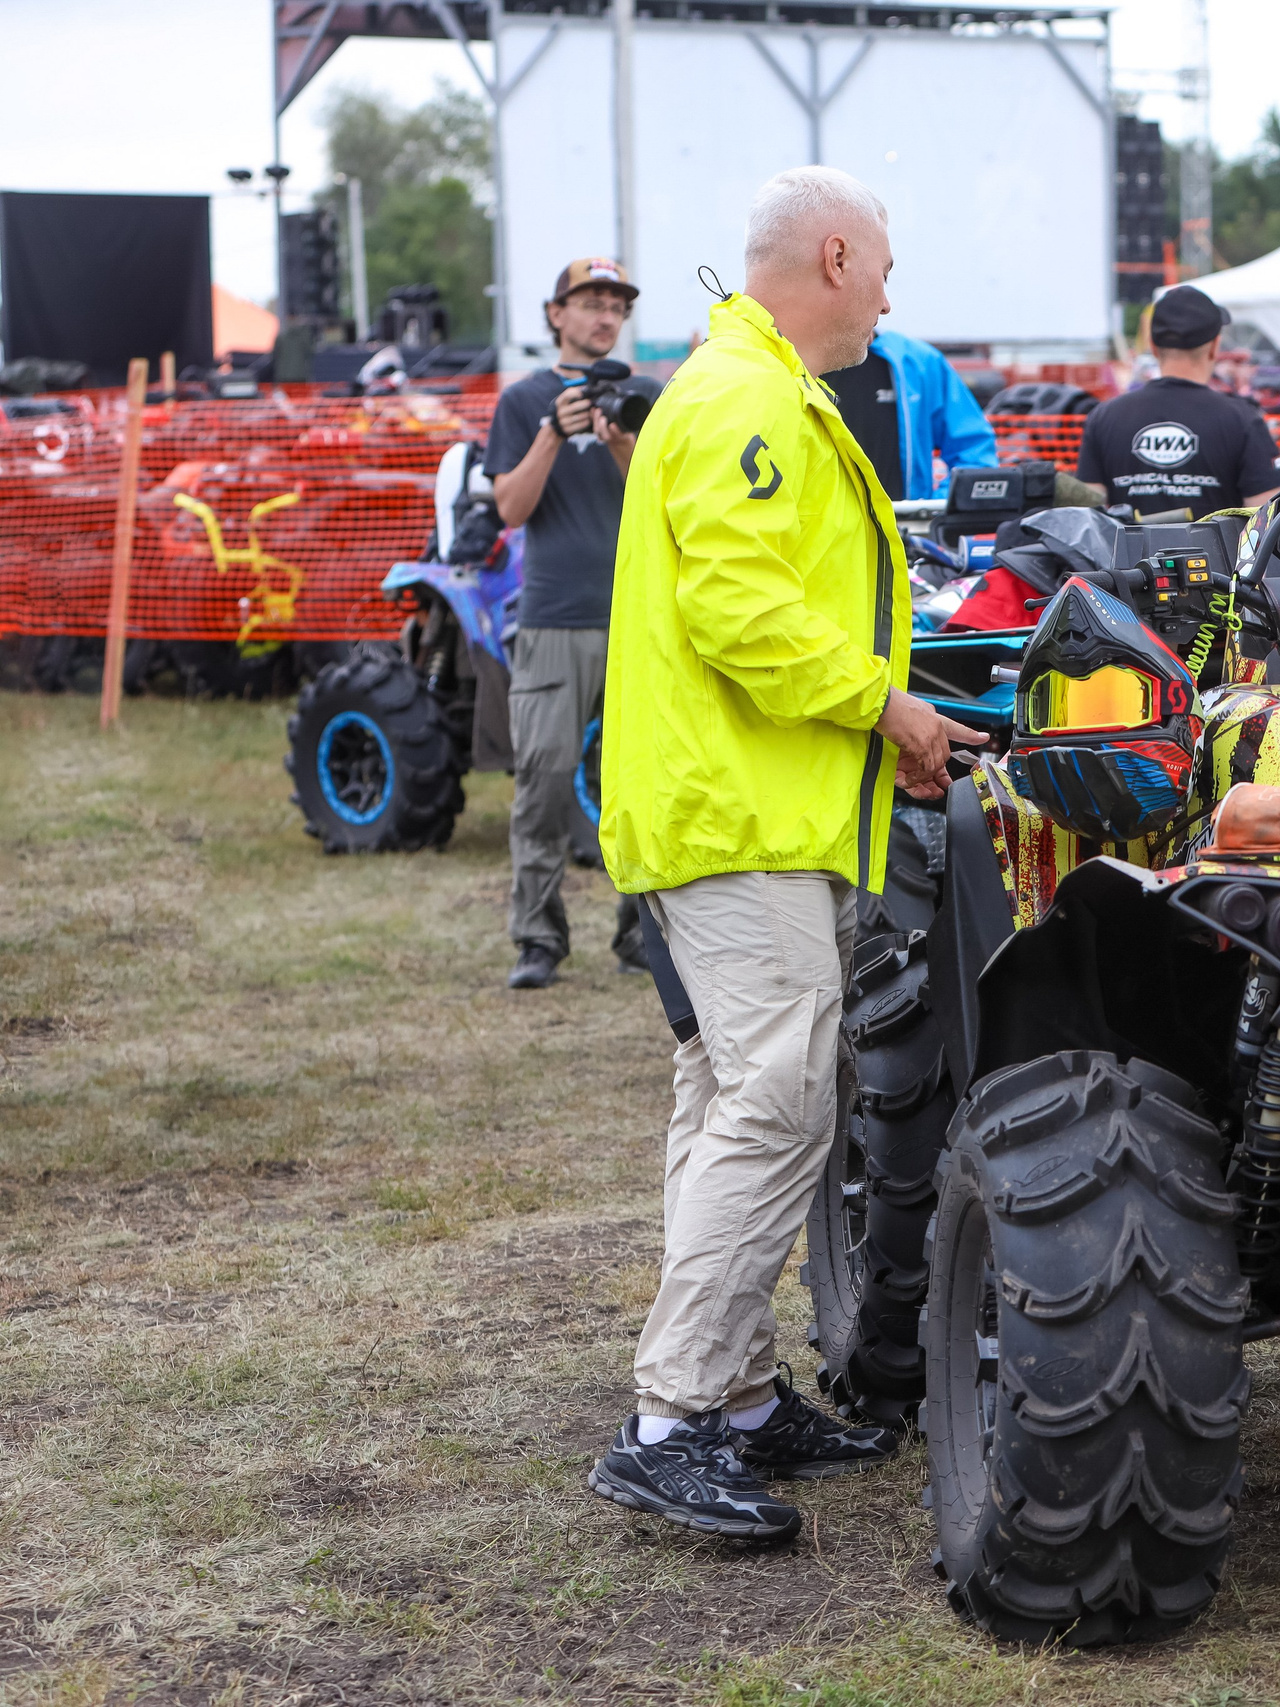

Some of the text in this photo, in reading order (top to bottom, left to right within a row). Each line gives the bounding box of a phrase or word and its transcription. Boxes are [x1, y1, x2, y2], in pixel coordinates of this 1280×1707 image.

[1136, 435, 1197, 451] AWM
[1112, 472, 1221, 488] TECHNICAL SCHOOL
[1089, 594, 1117, 626] AIROH
